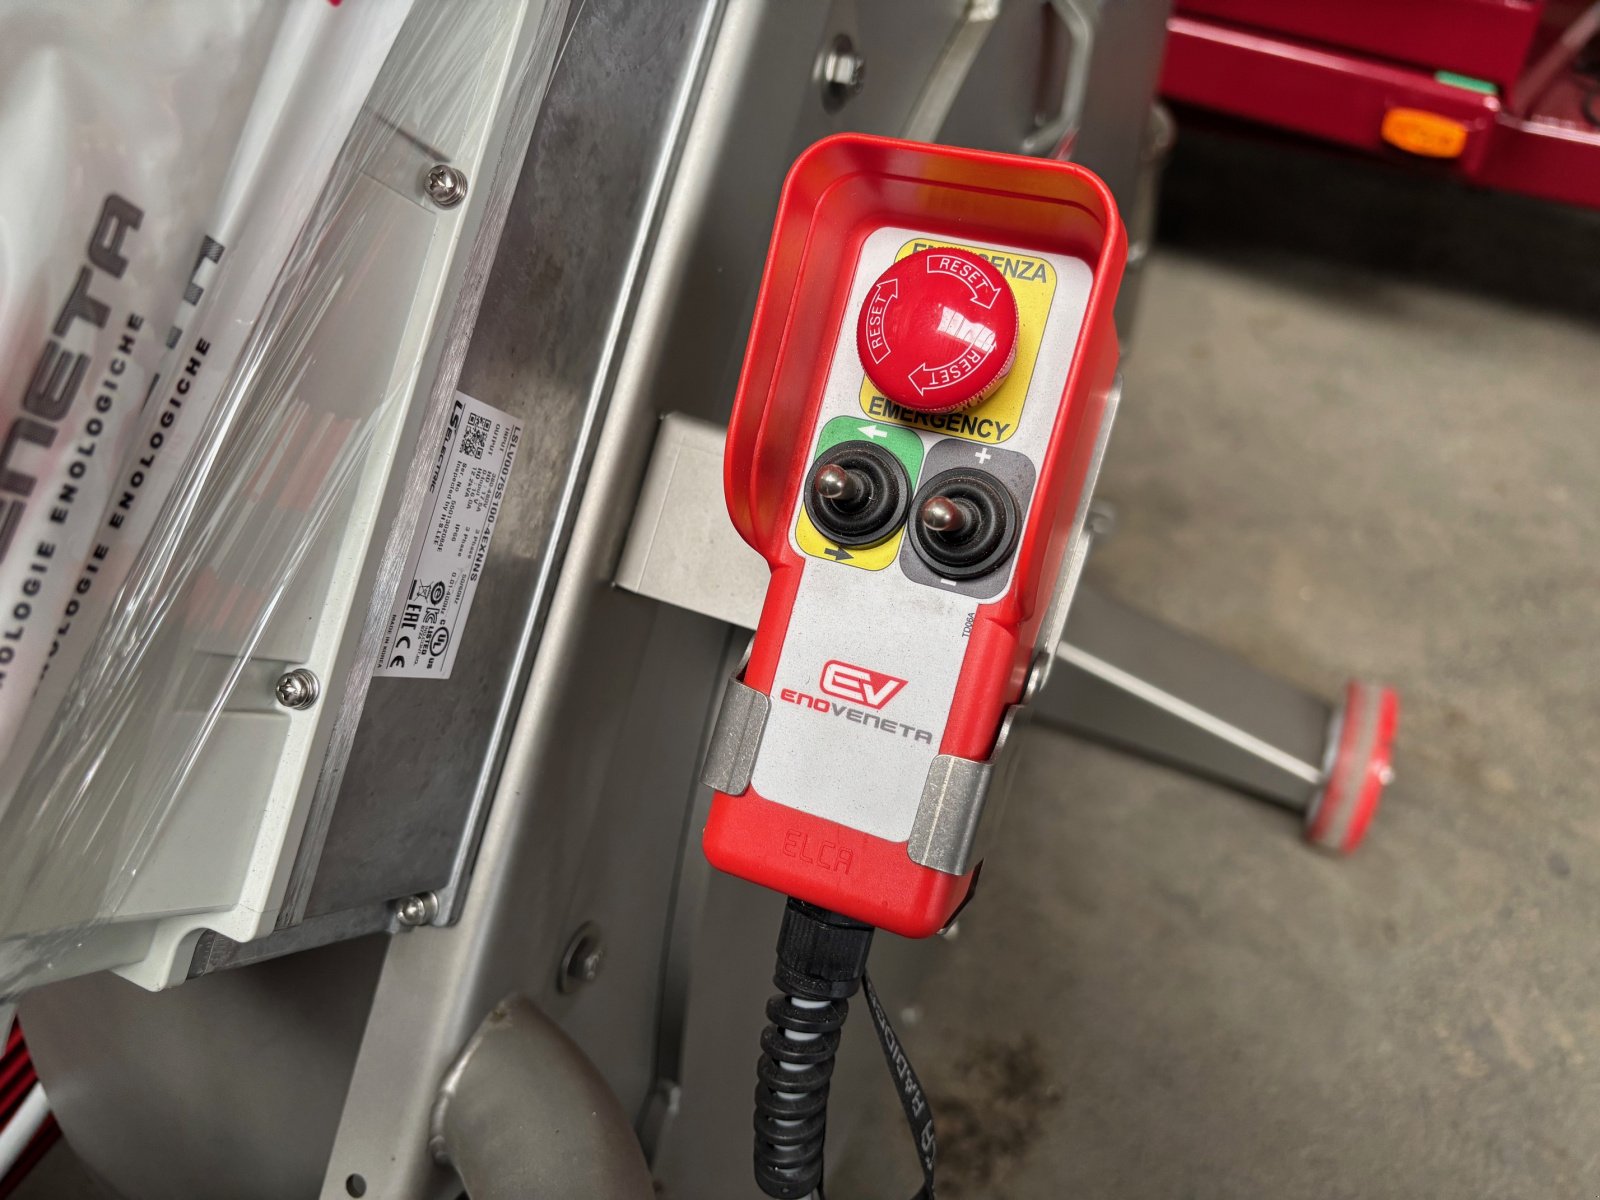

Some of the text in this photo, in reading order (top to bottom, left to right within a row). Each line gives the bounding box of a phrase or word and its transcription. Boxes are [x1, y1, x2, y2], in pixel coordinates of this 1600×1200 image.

[939, 257, 989, 290] RESET
[870, 294, 887, 349] RESET
[929, 350, 981, 385] RESET
[50, 311, 144, 525] ENOLOGICHE
[108, 337, 212, 532] ENOLOGICHE
[869, 395, 1010, 440] EMERGENCY
[430, 427, 453, 494] ELECTRIC
[488, 424, 500, 456] OUTPUT
[499, 428, 510, 452] INPUT
[446, 460, 462, 499] Inspected
[470, 425, 521, 581] LSLV0075S100-4EXNNS
[388, 614, 397, 634] MADE
[421, 626, 434, 655] LISTED
[783, 828, 854, 875] ELCA
